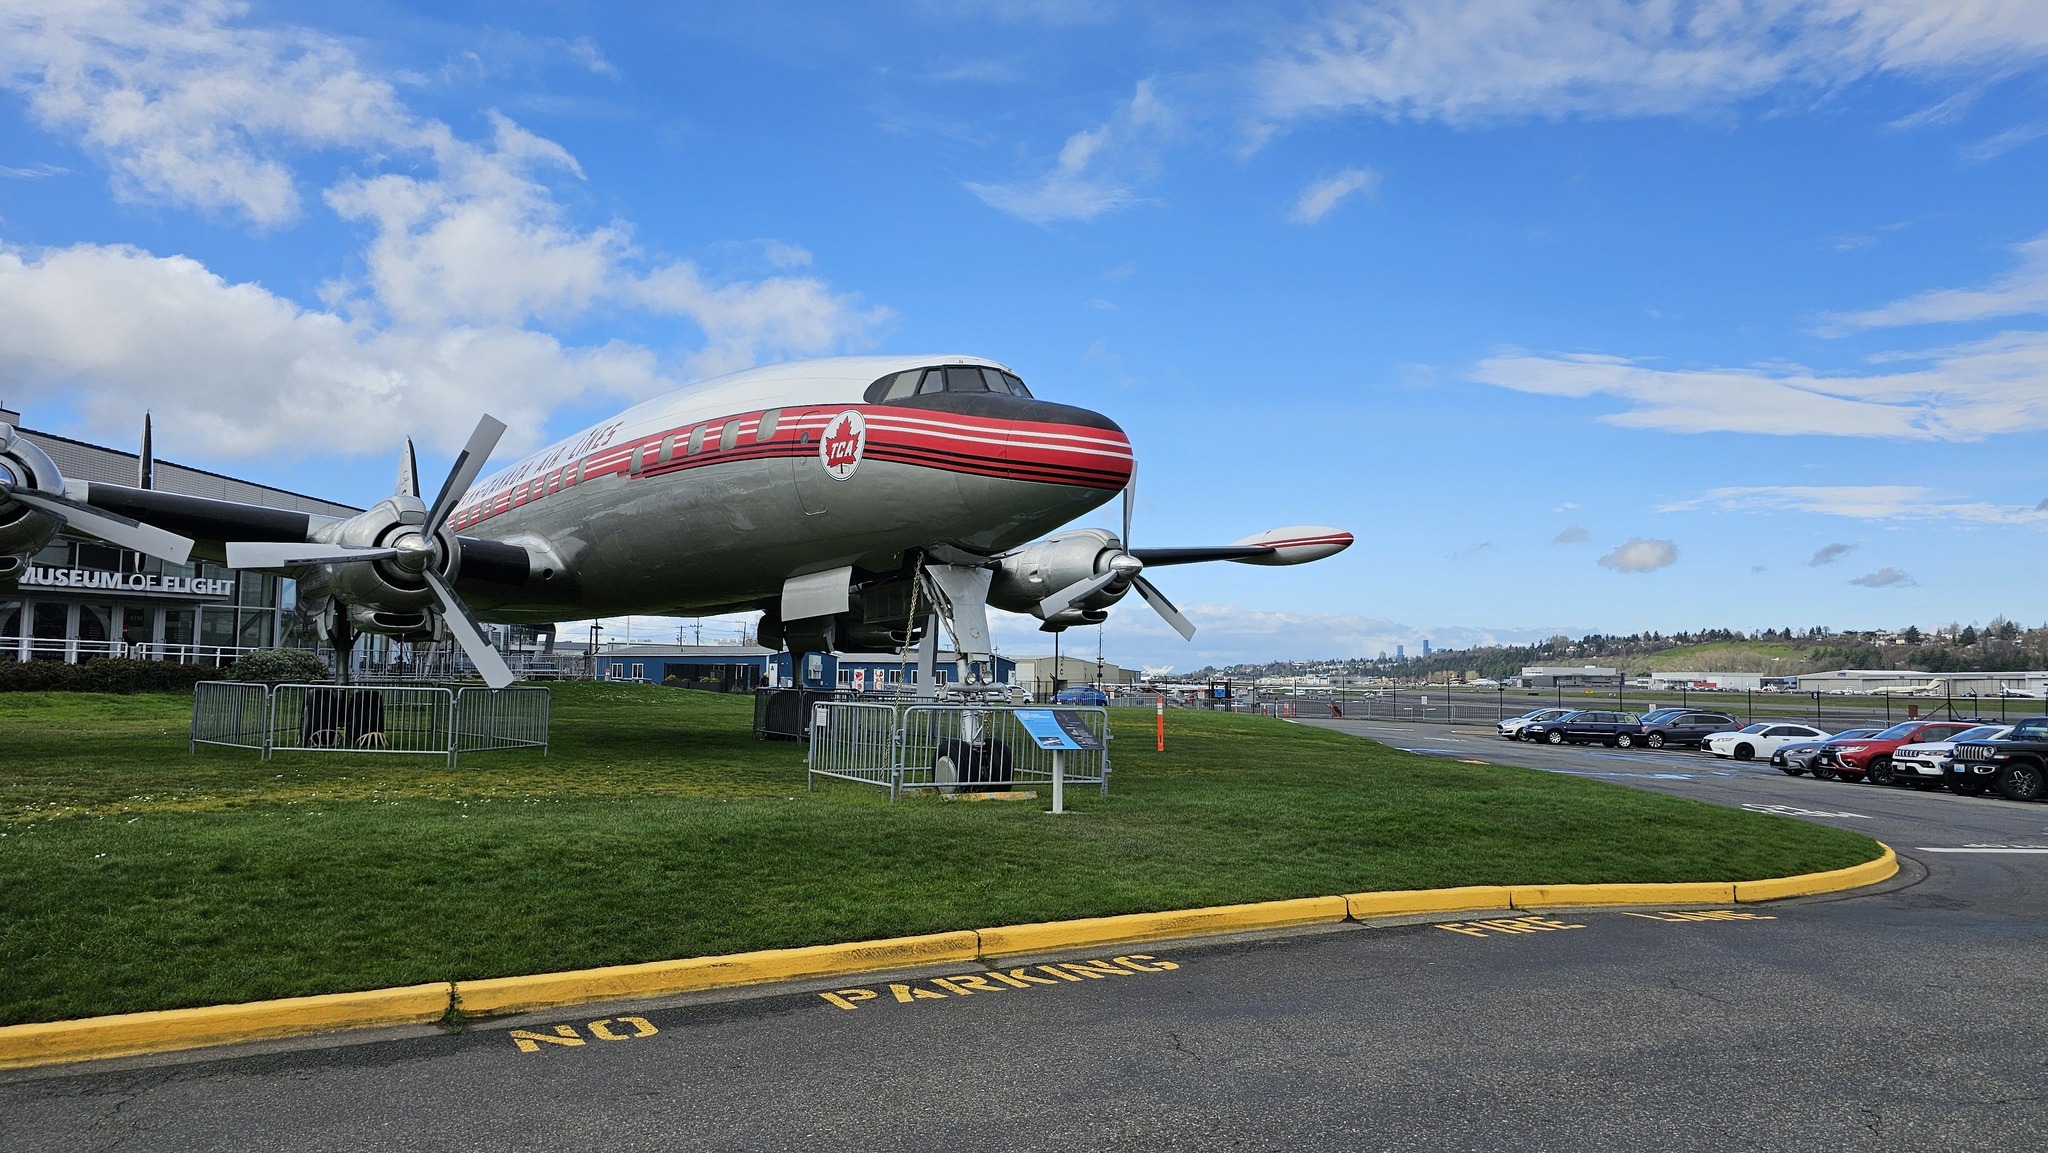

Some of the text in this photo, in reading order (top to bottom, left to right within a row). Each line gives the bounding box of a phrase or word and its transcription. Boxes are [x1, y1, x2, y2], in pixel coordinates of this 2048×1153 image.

[534, 446, 567, 475] AIR
[567, 421, 625, 461] LINES
[831, 440, 854, 459] TCA
[19, 567, 235, 596] MUSEUM OF FLIGHT
[509, 1016, 660, 1053] NO
[818, 955, 1180, 1010] PARKING
[1434, 916, 1587, 938] FIRE
